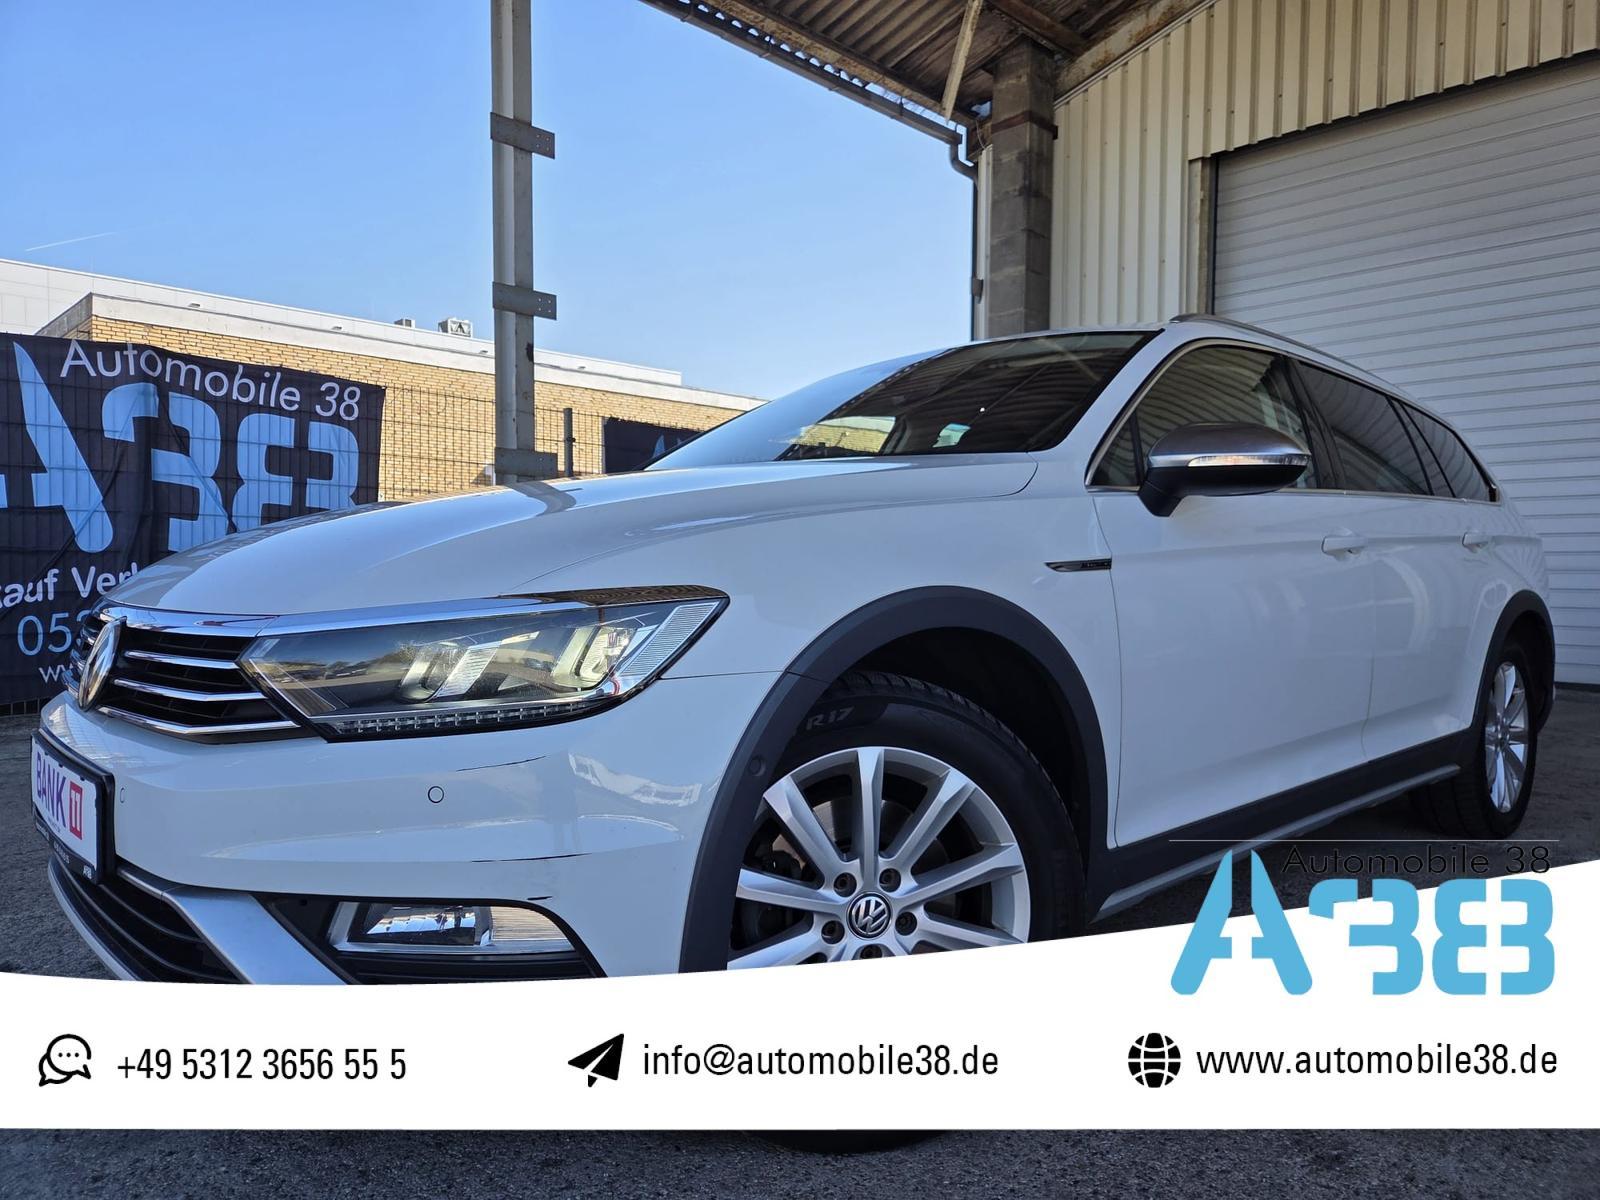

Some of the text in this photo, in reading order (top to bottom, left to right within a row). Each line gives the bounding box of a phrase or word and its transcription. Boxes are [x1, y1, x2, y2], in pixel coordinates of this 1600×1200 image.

[60, 339, 361, 421] Automobile 38
[0, 568, 60, 608] auf
[37, 751, 67, 828] BANK
